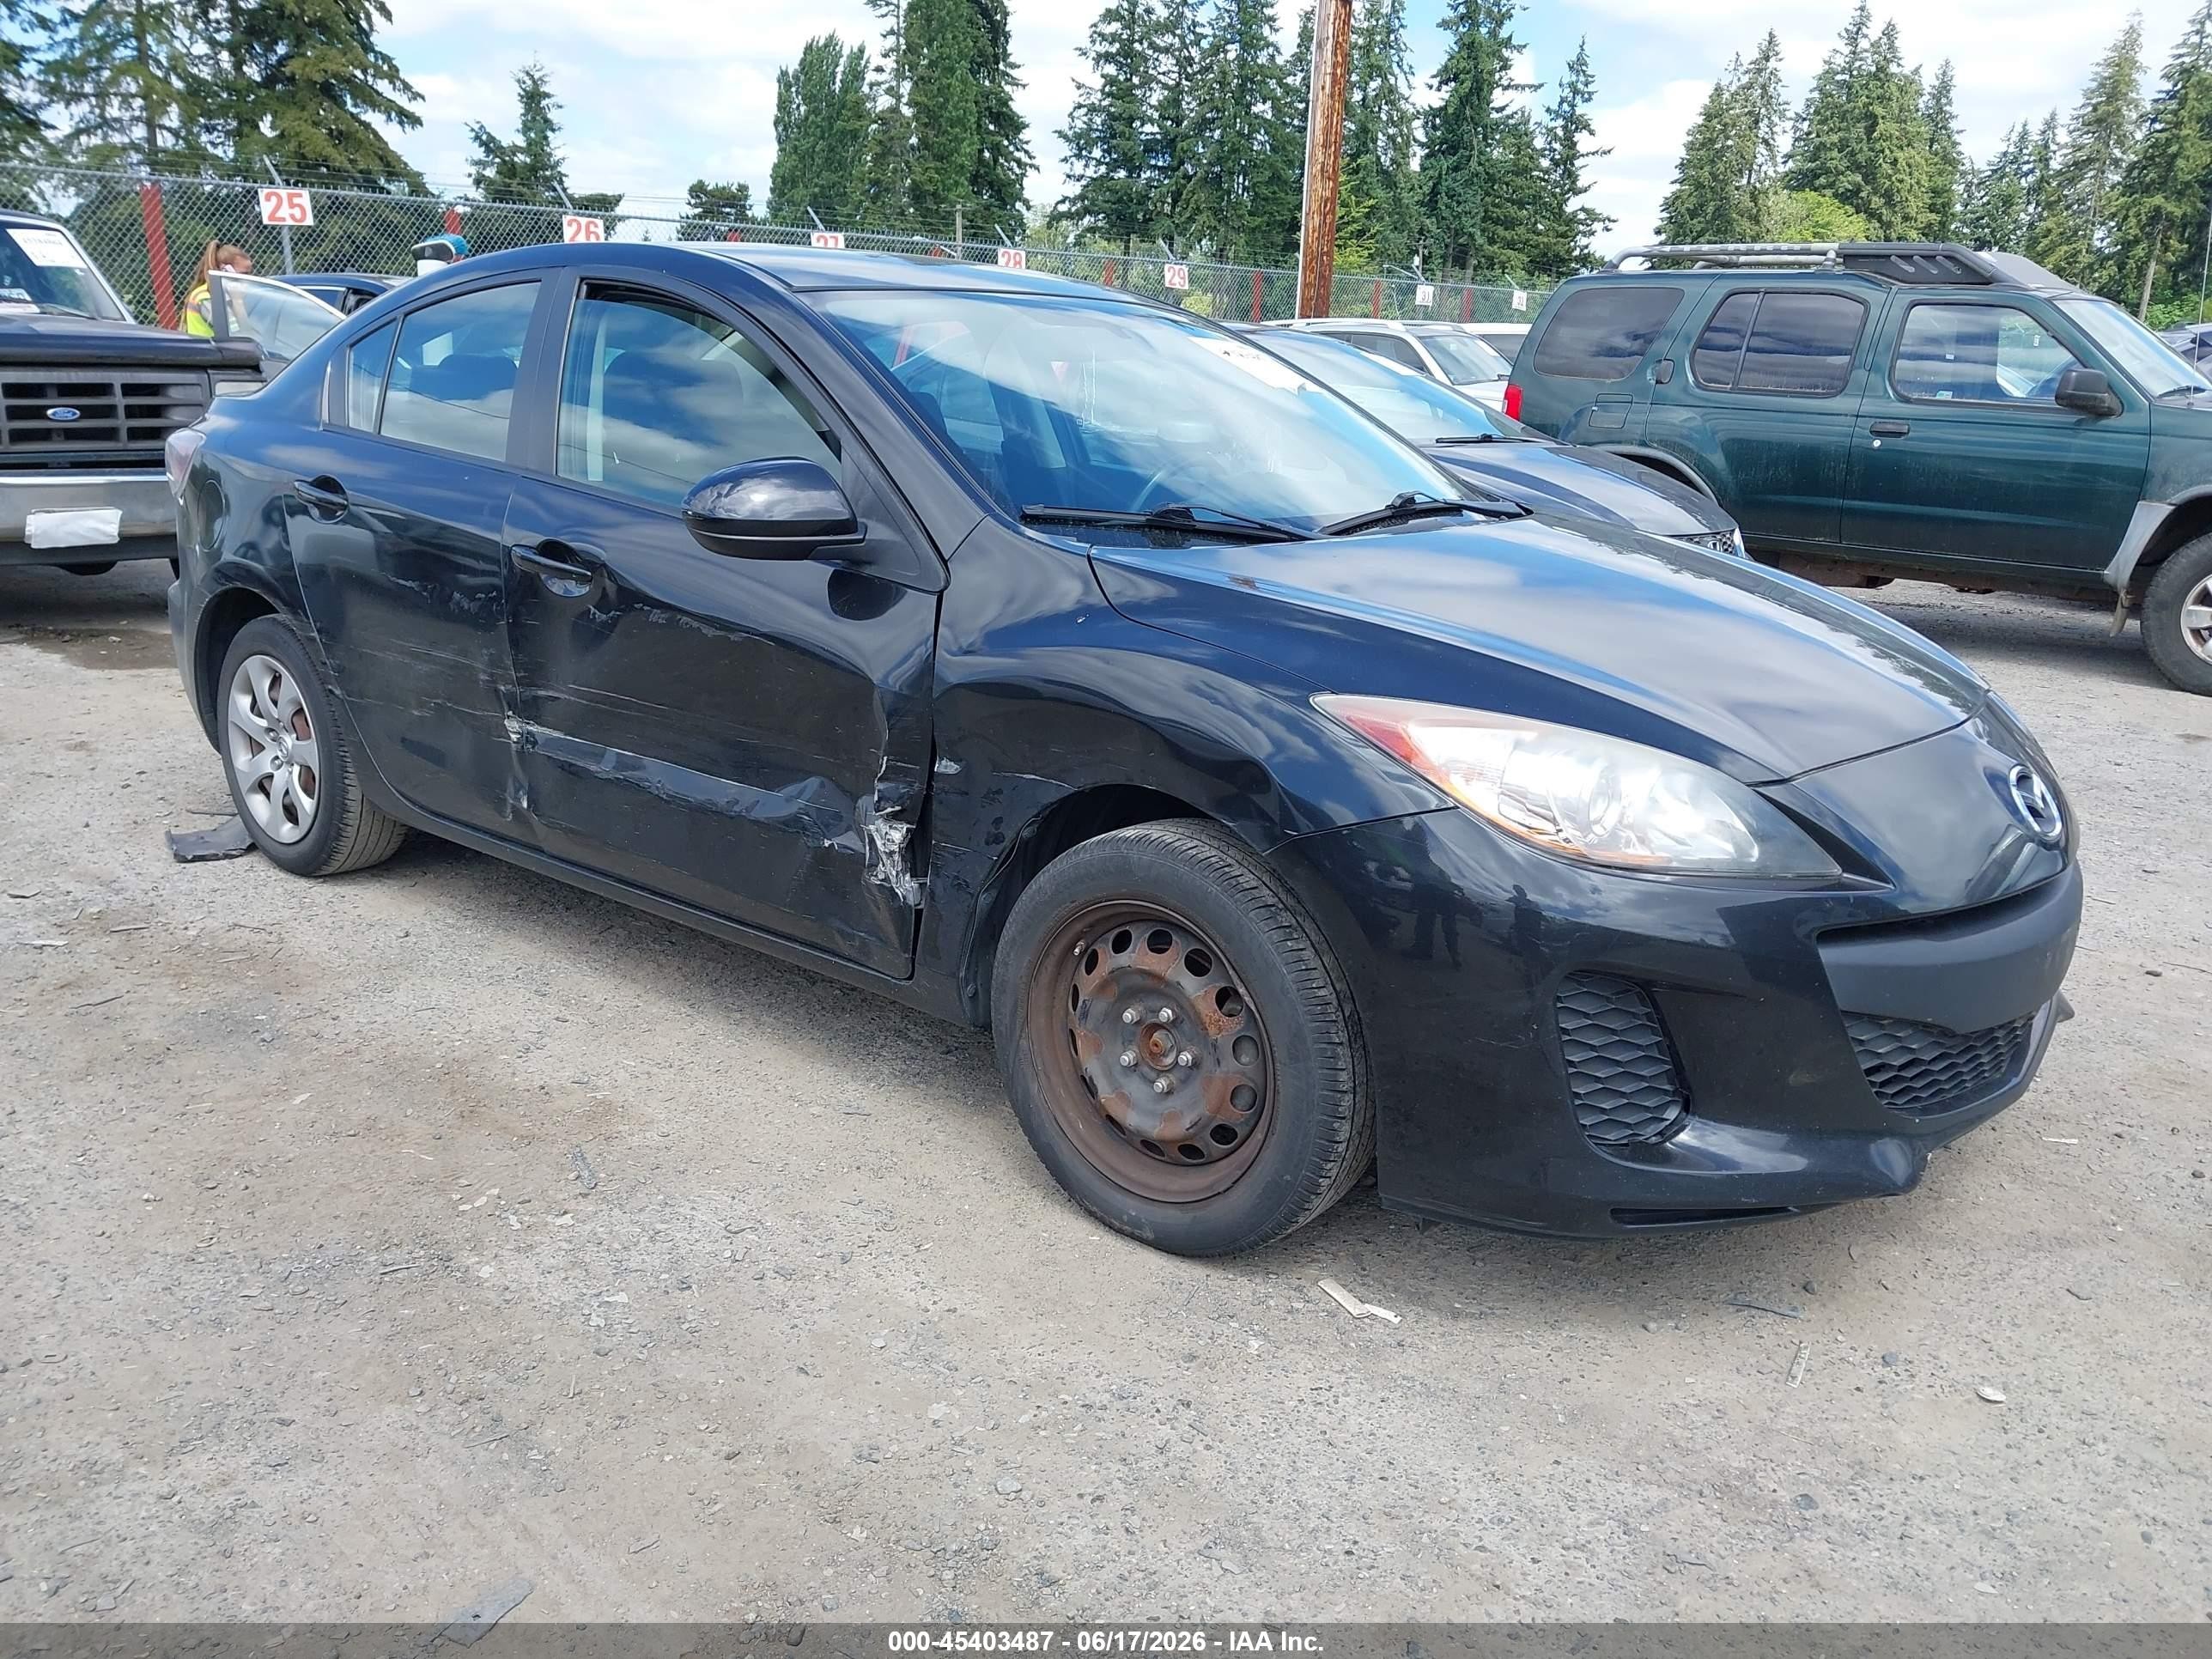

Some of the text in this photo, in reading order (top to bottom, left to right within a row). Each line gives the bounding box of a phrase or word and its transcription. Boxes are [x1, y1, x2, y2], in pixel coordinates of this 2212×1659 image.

[264, 191, 307, 222] 25
[567, 218, 600, 242] 26
[1001, 251, 1022, 268] 28
[1168, 266, 1186, 287] 29
